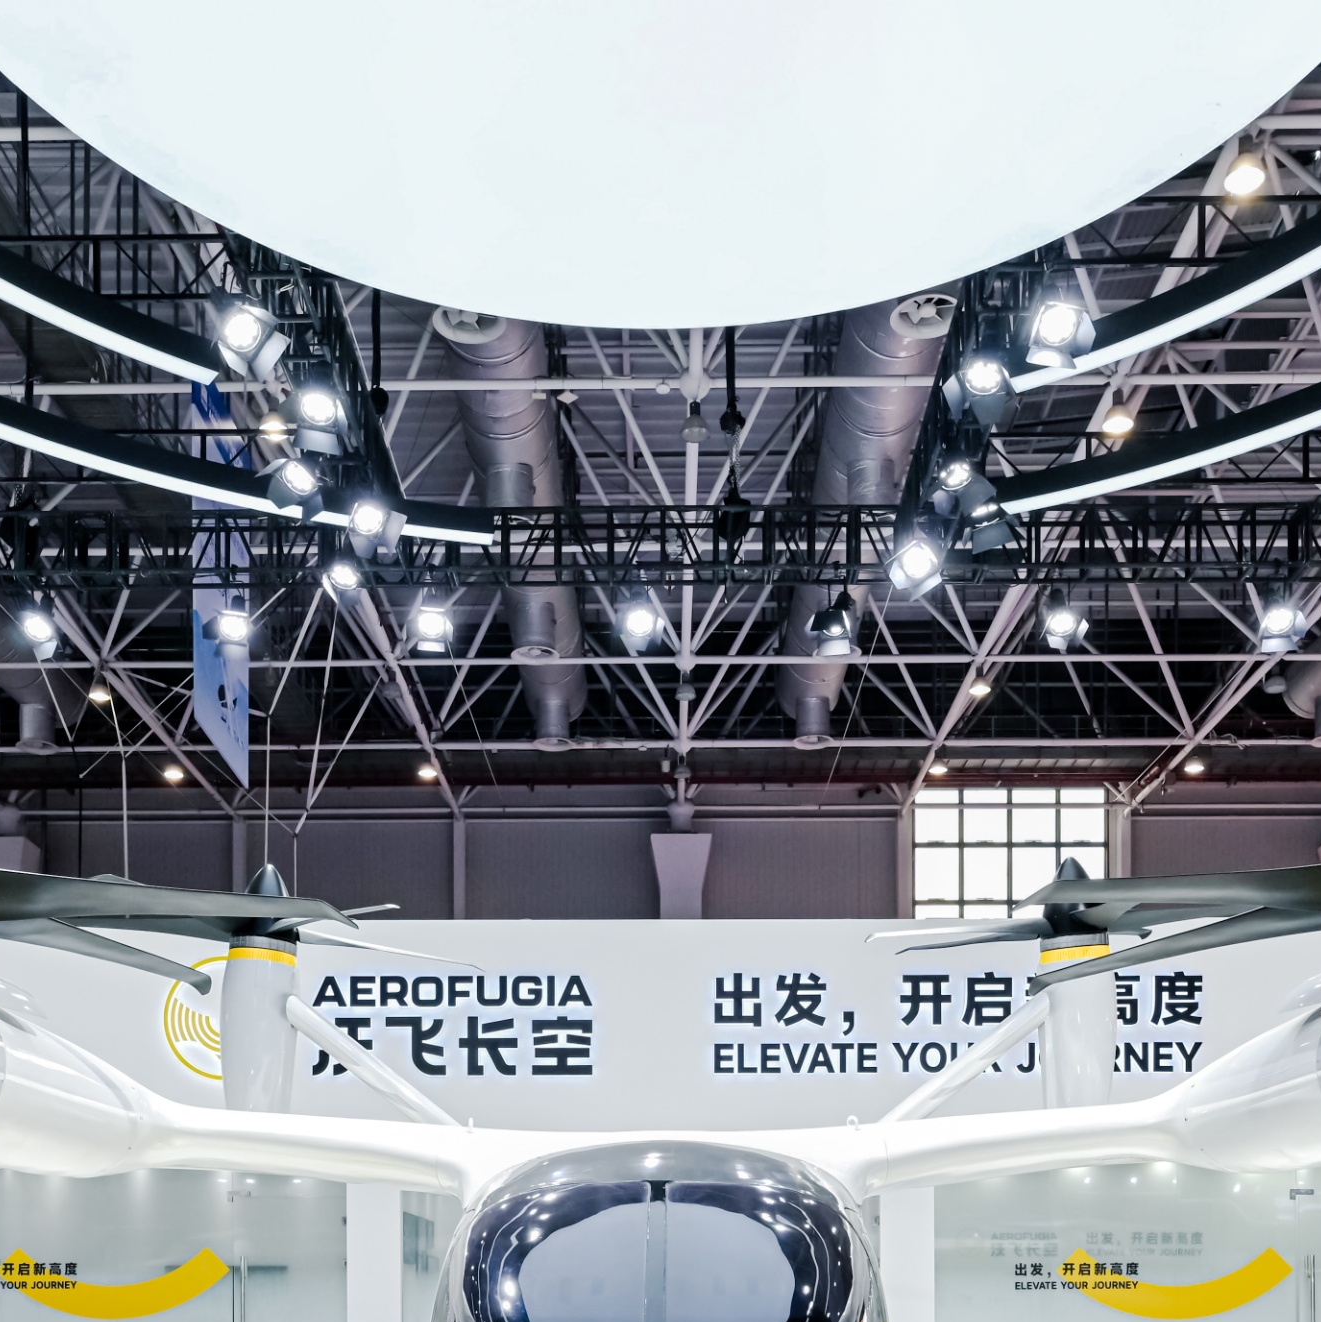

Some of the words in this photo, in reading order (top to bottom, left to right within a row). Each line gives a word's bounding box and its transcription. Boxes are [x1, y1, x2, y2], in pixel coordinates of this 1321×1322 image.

[312, 975, 593, 1007] AEROFUGIA
[714, 1043, 878, 1074] ELEVATE
[1014, 1262, 1139, 1278] 出发，开启新高度
[0, 1280, 28, 1290] YOUR
[31, 1280, 78, 1290] JOURNEY
[1014, 1280, 1058, 1290] ELEVATE
[1060, 1280, 1089, 1290] YOUR
[1091, 1280, 1139, 1290] JOURNEY
